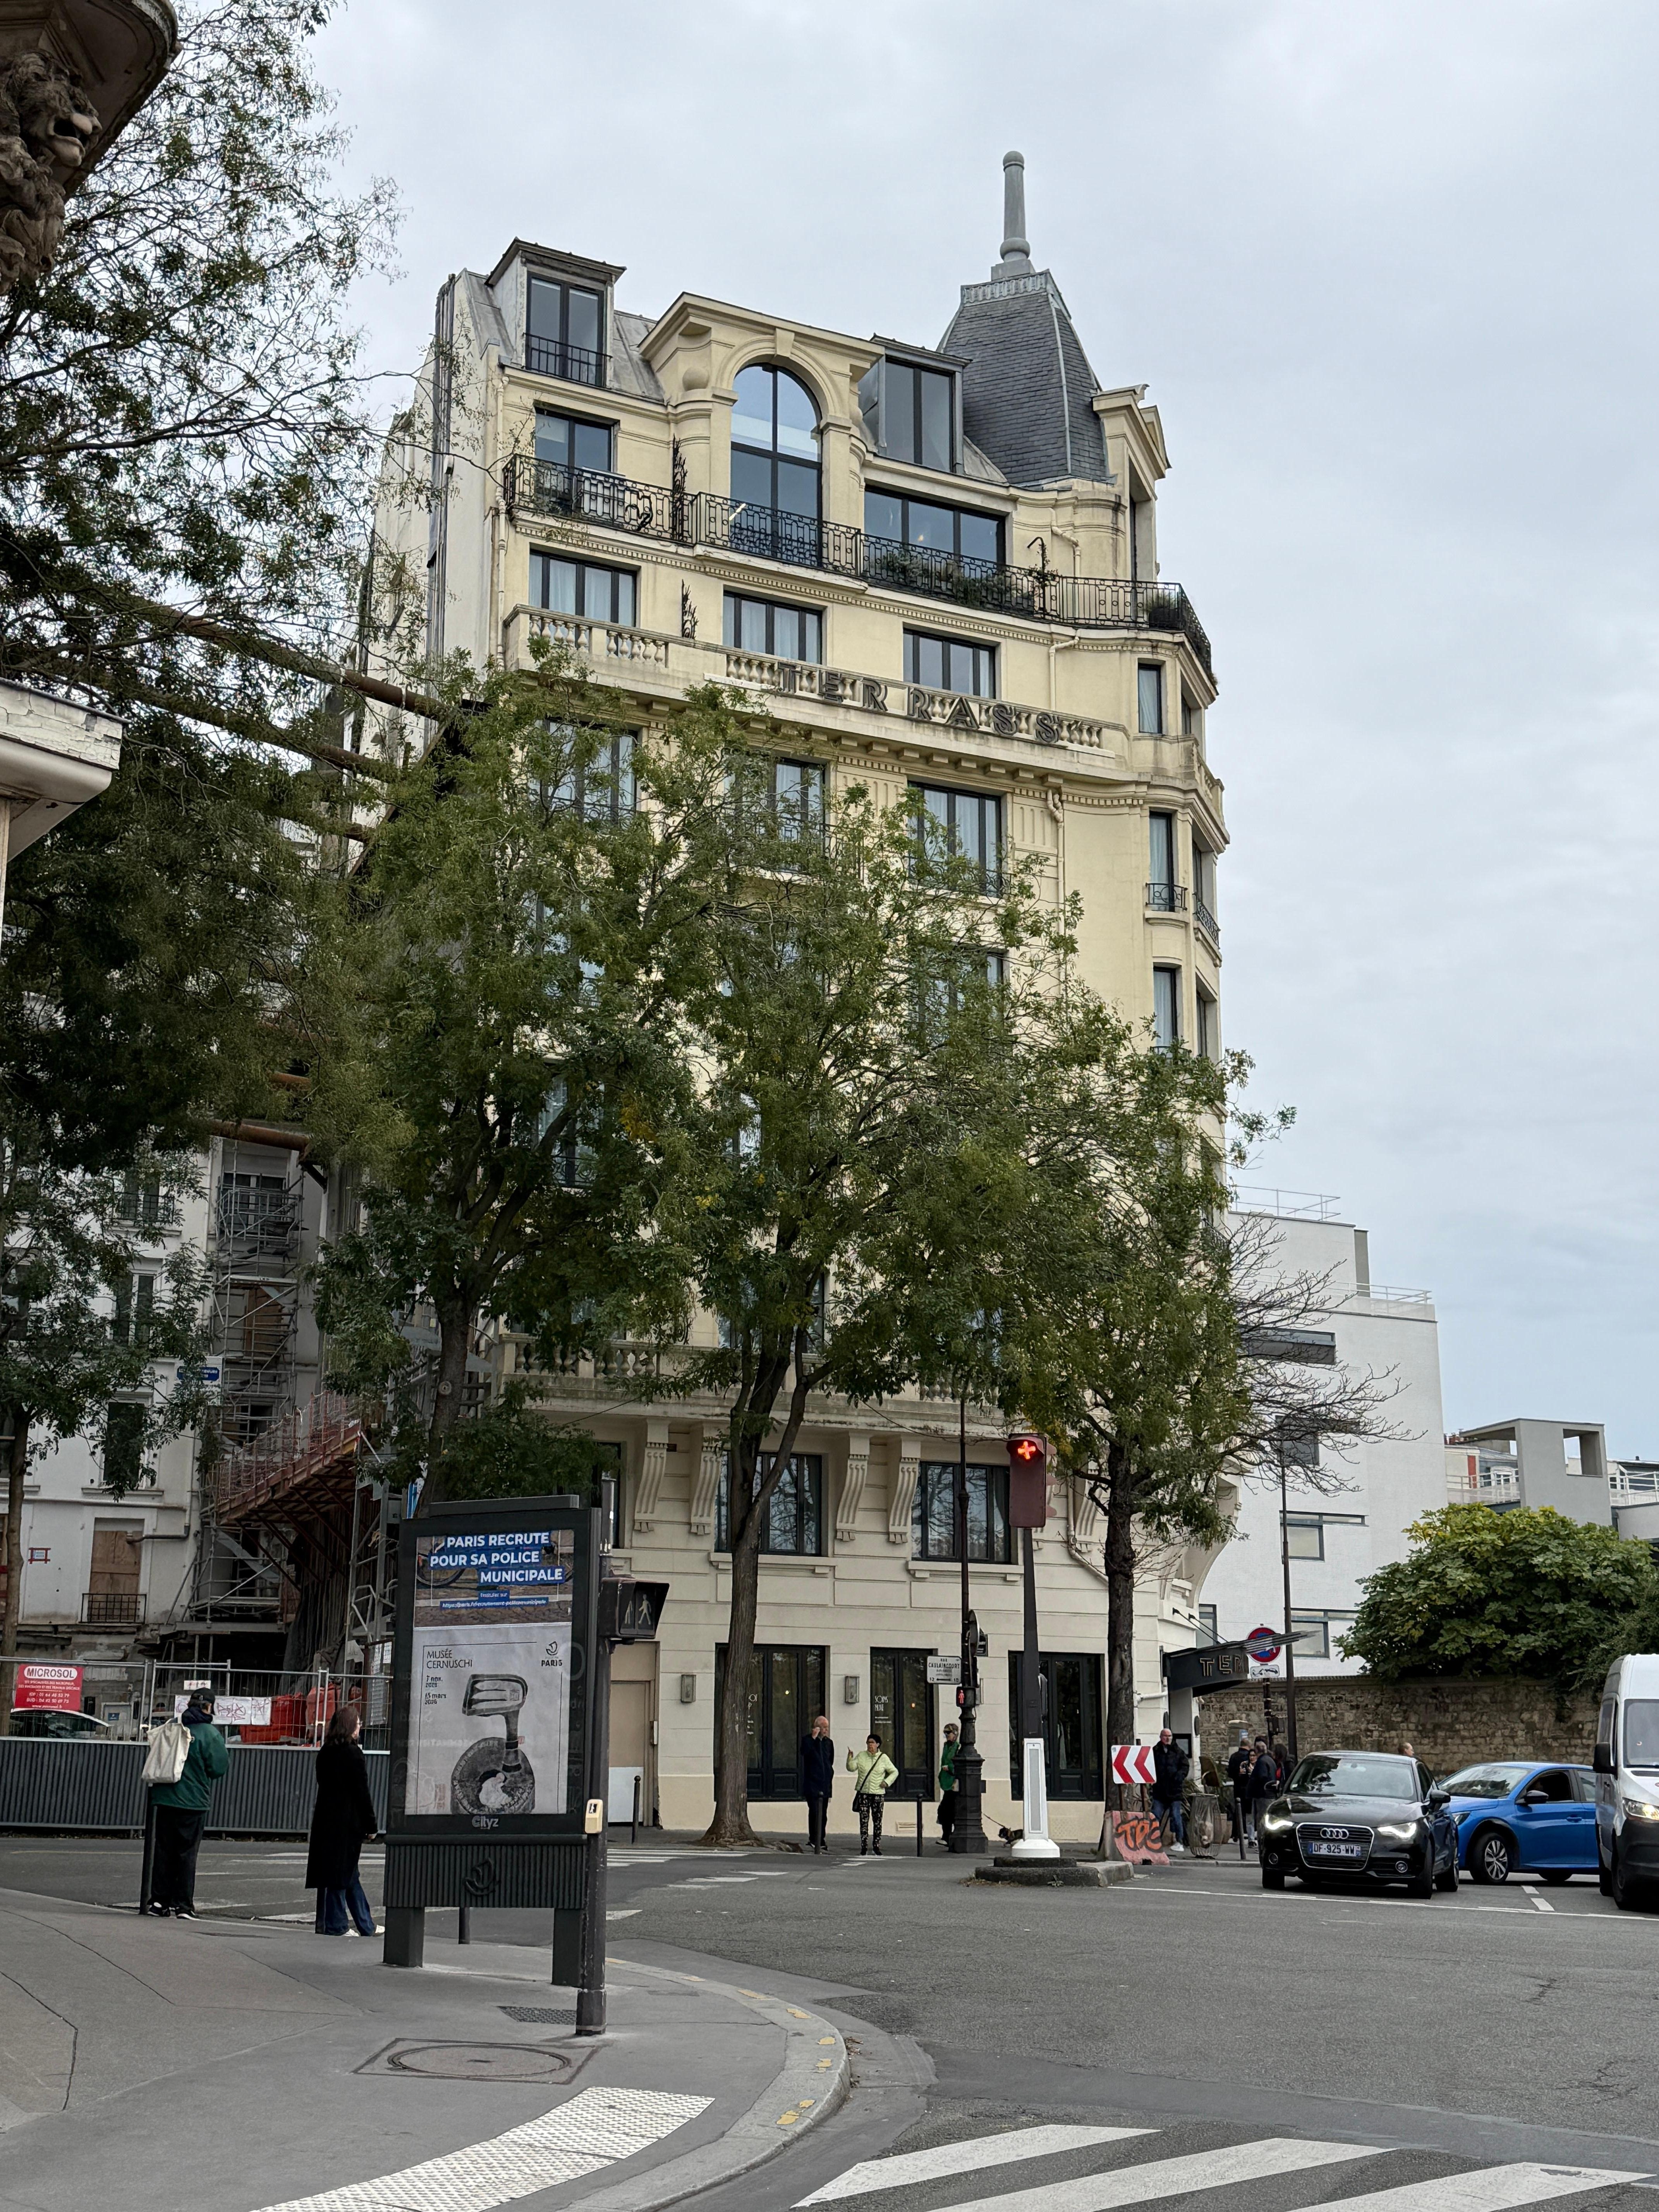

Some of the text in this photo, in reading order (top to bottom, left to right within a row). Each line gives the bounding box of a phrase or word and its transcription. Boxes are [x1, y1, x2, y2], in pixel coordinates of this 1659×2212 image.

[776, 661, 1058, 743] TERRASS
[447, 1532, 549, 1548] PARIS RECRUTE
[430, 1551, 539, 1567] POUR SA POLICE
[481, 1568, 563, 1583] MUNICIPALE
[427, 1649, 452, 1659] MUSÉE
[427, 1659, 472, 1669] CERNUSCHI
[27, 1668, 74, 1678] MICROSOL
